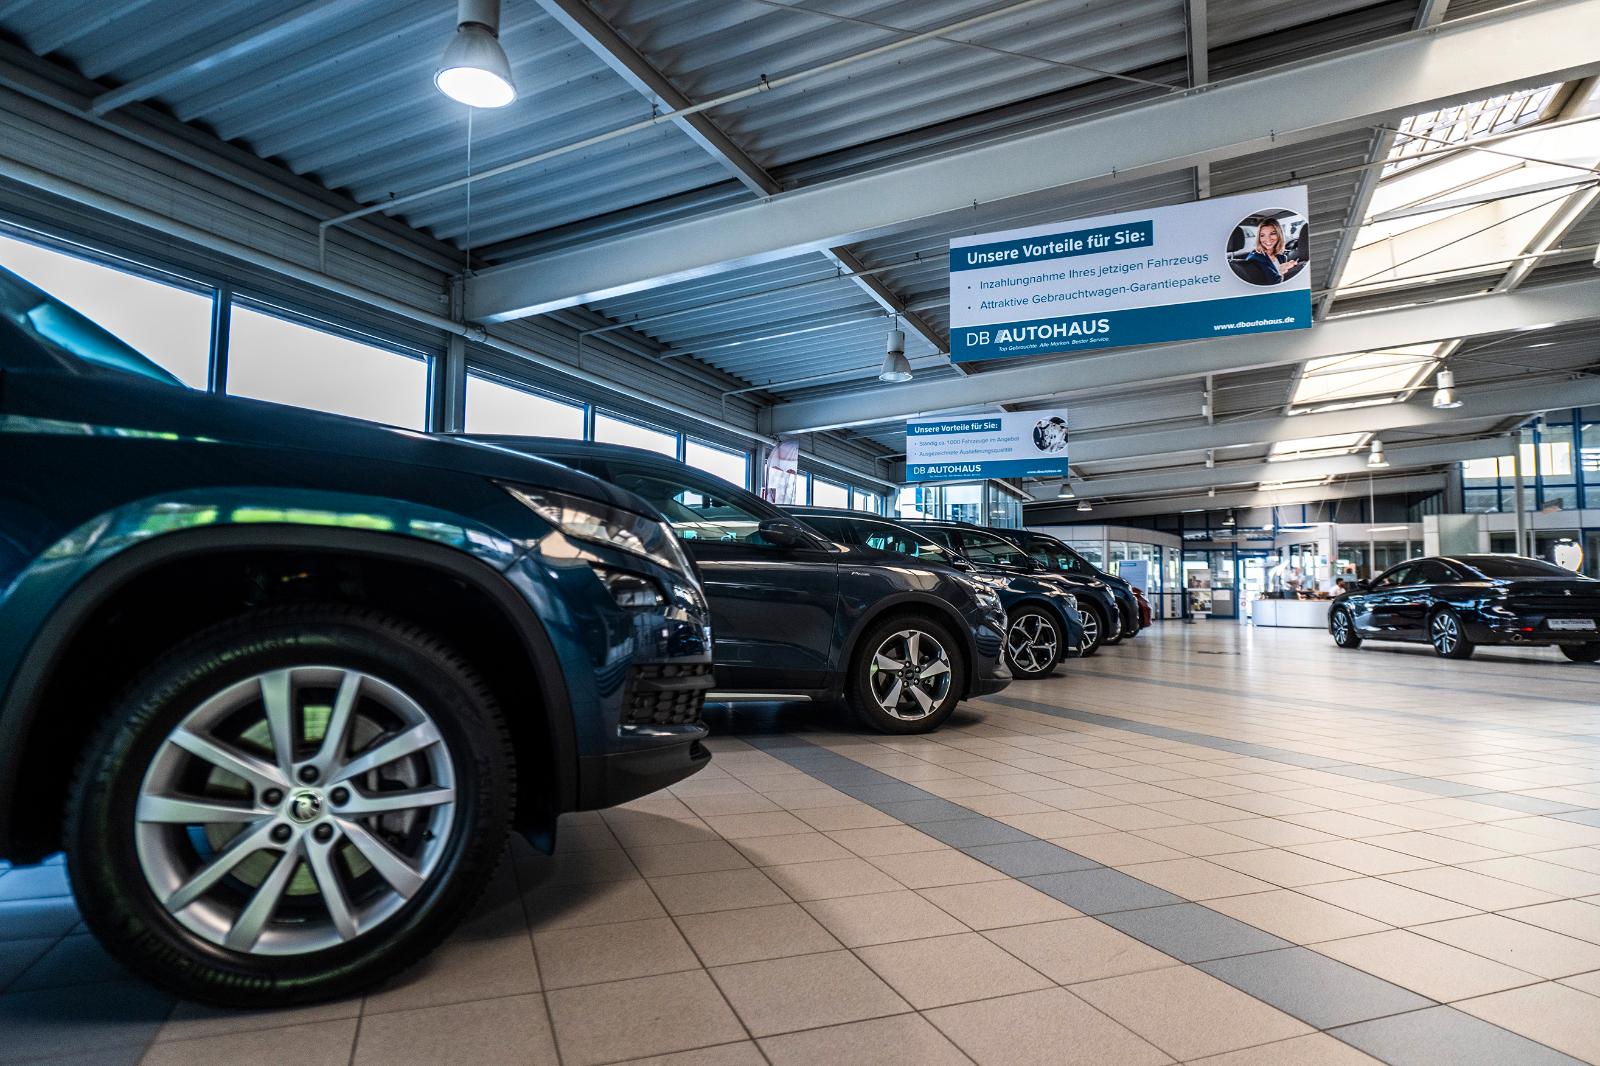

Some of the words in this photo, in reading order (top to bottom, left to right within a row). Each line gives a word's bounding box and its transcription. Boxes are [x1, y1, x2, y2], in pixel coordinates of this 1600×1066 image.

[967, 248, 1019, 265] Unsere
[1022, 238, 1083, 257] Vorteile
[1087, 234, 1111, 249] für
[1115, 230, 1145, 245] Sie:
[980, 272, 1066, 290] Inzahlungnahme
[1069, 268, 1096, 279] Ihres
[1097, 263, 1144, 278] jetzigen
[1147, 253, 1209, 269] Fahrzeugs
[980, 297, 1029, 310] Attraktive
[1032, 274, 1221, 304] Gebrauchtwagen-Garantiepakete
[966, 331, 990, 346] DB
[994, 318, 1110, 344] AUTOHAUS
[1213, 317, 1295, 331] www.dbautohaus.de
[914, 426, 940, 434] Unsere
[941, 423, 970, 432] Vorteile
[971, 422, 982, 430] für
[983, 421, 998, 429] Sie:
[913, 466, 926, 475] DB
[927, 464, 981, 474] AUTOHAUS
